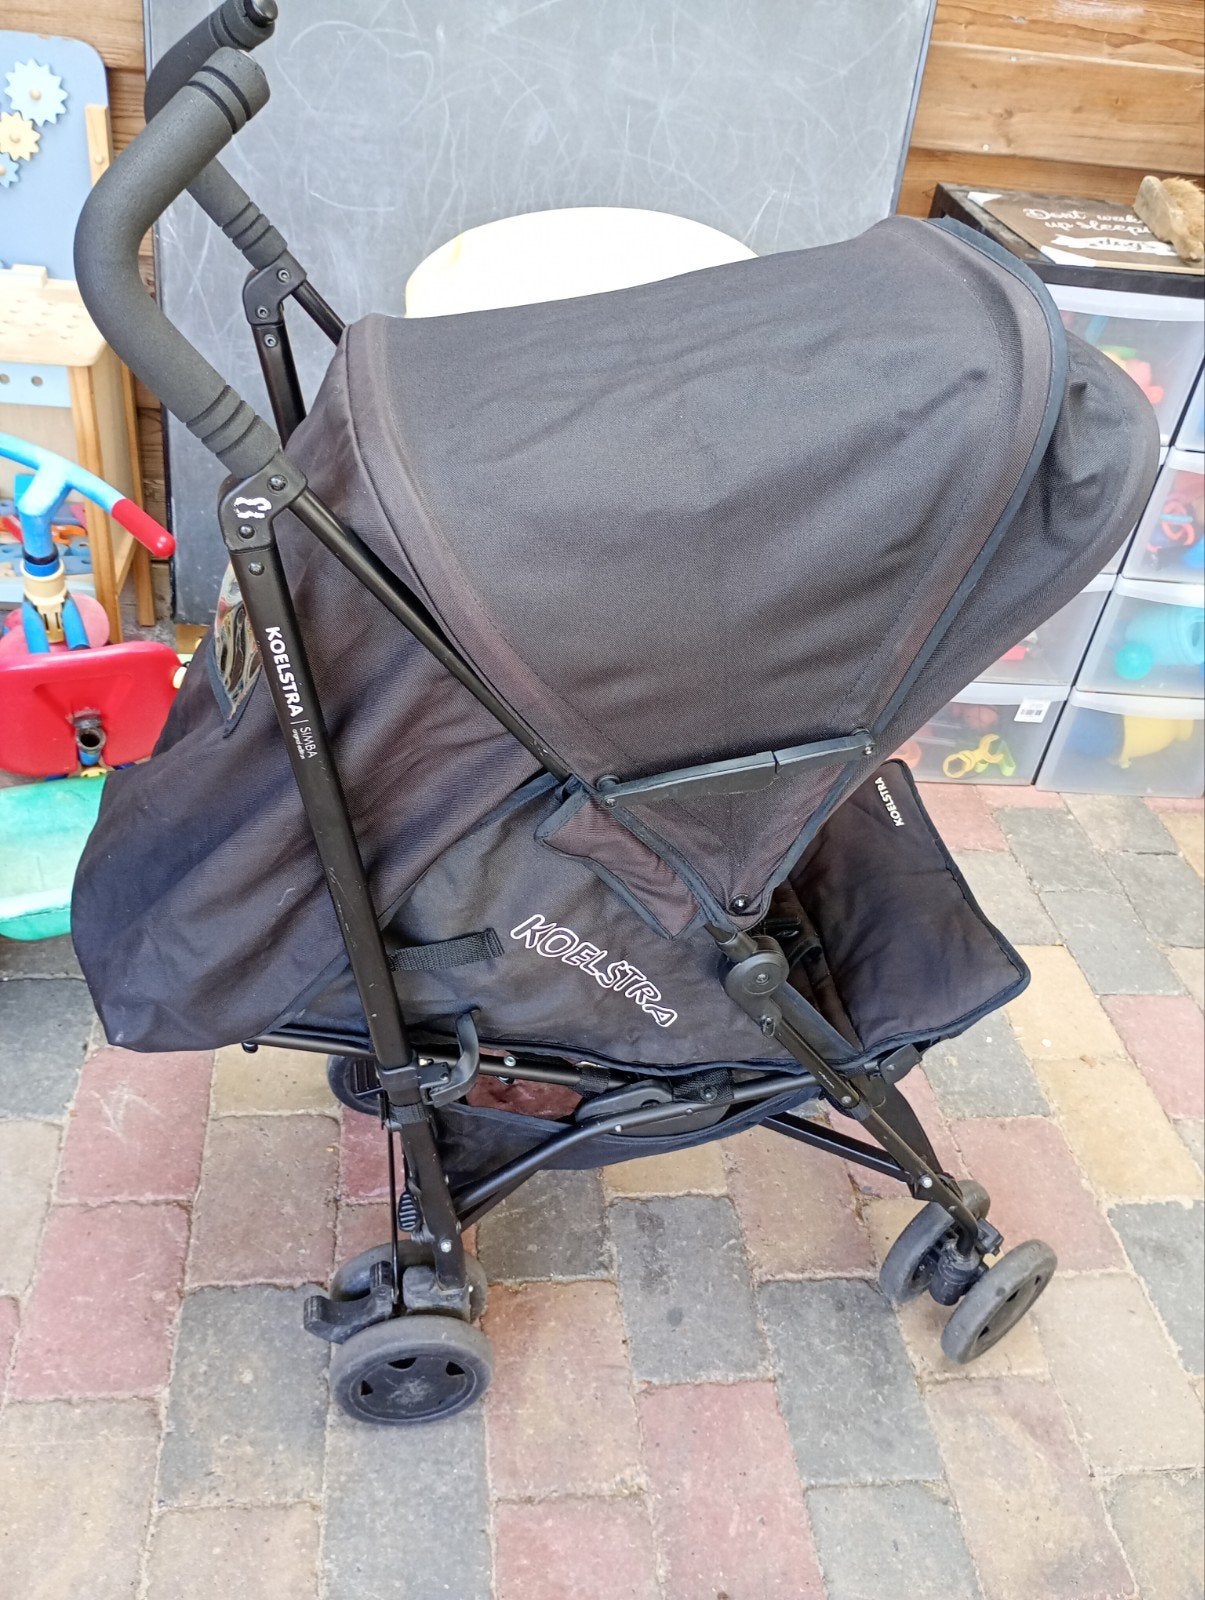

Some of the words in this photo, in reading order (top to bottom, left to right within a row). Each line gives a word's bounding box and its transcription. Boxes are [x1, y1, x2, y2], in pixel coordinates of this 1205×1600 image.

[265, 626, 304, 718] KOELSTRA
[300, 726, 318, 759] SIMBA
[874, 776, 905, 827] KOELSTRA
[510, 913, 678, 1028] KOELSTRA
